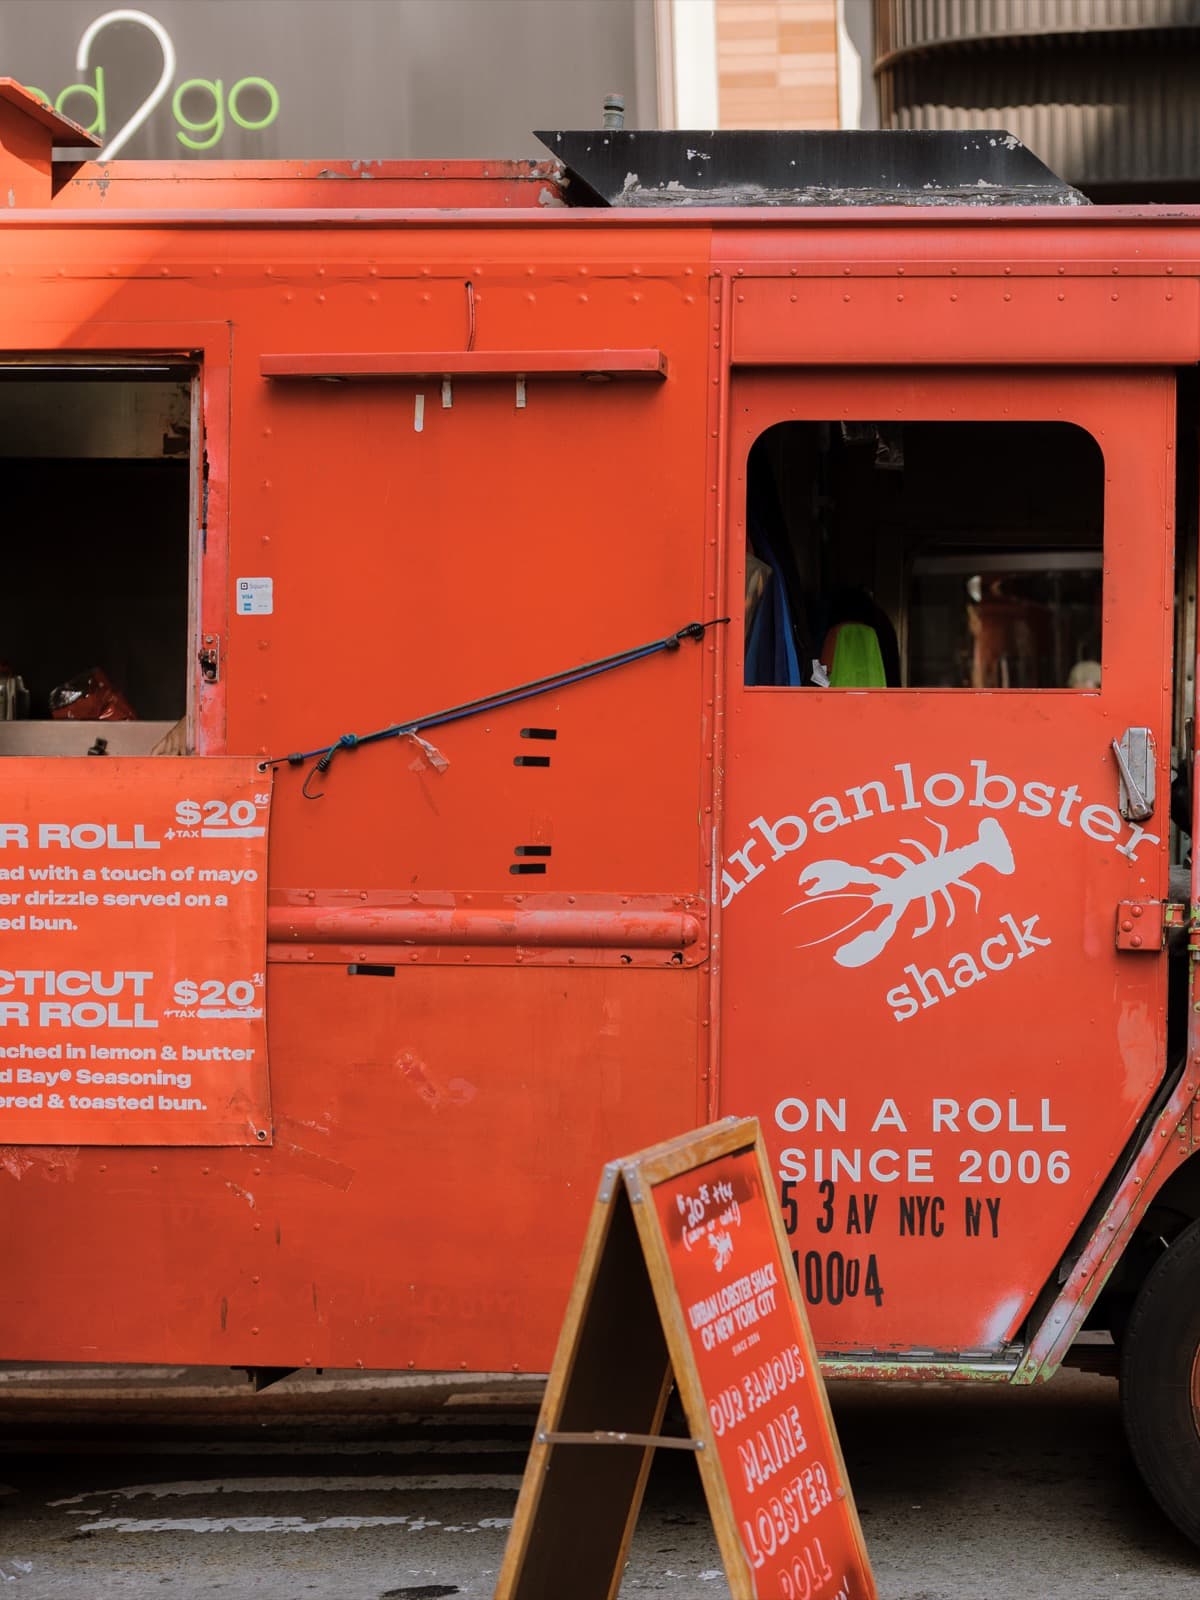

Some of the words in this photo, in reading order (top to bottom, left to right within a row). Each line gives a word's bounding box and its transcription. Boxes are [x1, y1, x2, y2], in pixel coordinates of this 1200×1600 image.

[24, 9, 279, 161] d2go
[175, 798, 257, 828] $20
[38, 824, 160, 849] ROLL
[721, 759, 1160, 908] urbanlobster
[28, 864, 78, 881] with
[82, 868, 97, 881] a
[101, 865, 166, 881] touch
[170, 866, 194, 881] of
[198, 868, 258, 884] mayo
[25, 889, 99, 906] drizzle
[103, 891, 180, 906] served
[184, 893, 211, 906] on
[215, 894, 228, 907] a
[30, 916, 78, 931] bun.
[886, 912, 1051, 1021] shack
[173, 978, 255, 1007] $20
[40, 1002, 158, 1028] ROLL
[66, 1043, 86, 1059] in
[90, 1044, 156, 1060] lemon
[160, 1046, 177, 1061] &
[182, 1045, 255, 1061] butter
[76, 1069, 191, 1089] Seasoning
[0, 1093, 42, 1108] red
[47, 1093, 64, 1109] &
[69, 1094, 154, 1110] toasted
[158, 1095, 207, 1111] bun.
[774, 1097, 846, 1133] ON
[871, 1098, 907, 1132] A
[932, 1097, 1067, 1133] ROLL
[778, 1148, 934, 1183] SINCE
[959, 1149, 1071, 1184] 2006
[816, 1179, 835, 1234] 3
[846, 1194, 878, 1235] AV
[899, 1196, 945, 1237] NYC
[965, 1196, 1001, 1238] NY
[688, 1293, 720, 1331] URBAN
[716, 1275, 754, 1314] LOBSTER
[750, 1262, 778, 1295] SHACK
[701, 1323, 716, 1351] OF
[713, 1312, 735, 1344] NEW
[732, 1298, 760, 1332] YORK
[757, 1287, 776, 1317] CITY
[709, 1385, 746, 1437] OUR
[741, 1343, 805, 1413] FAMOUS
[737, 1404, 807, 1493] MAINE
[743, 1460, 833, 1569] LOBSTER
